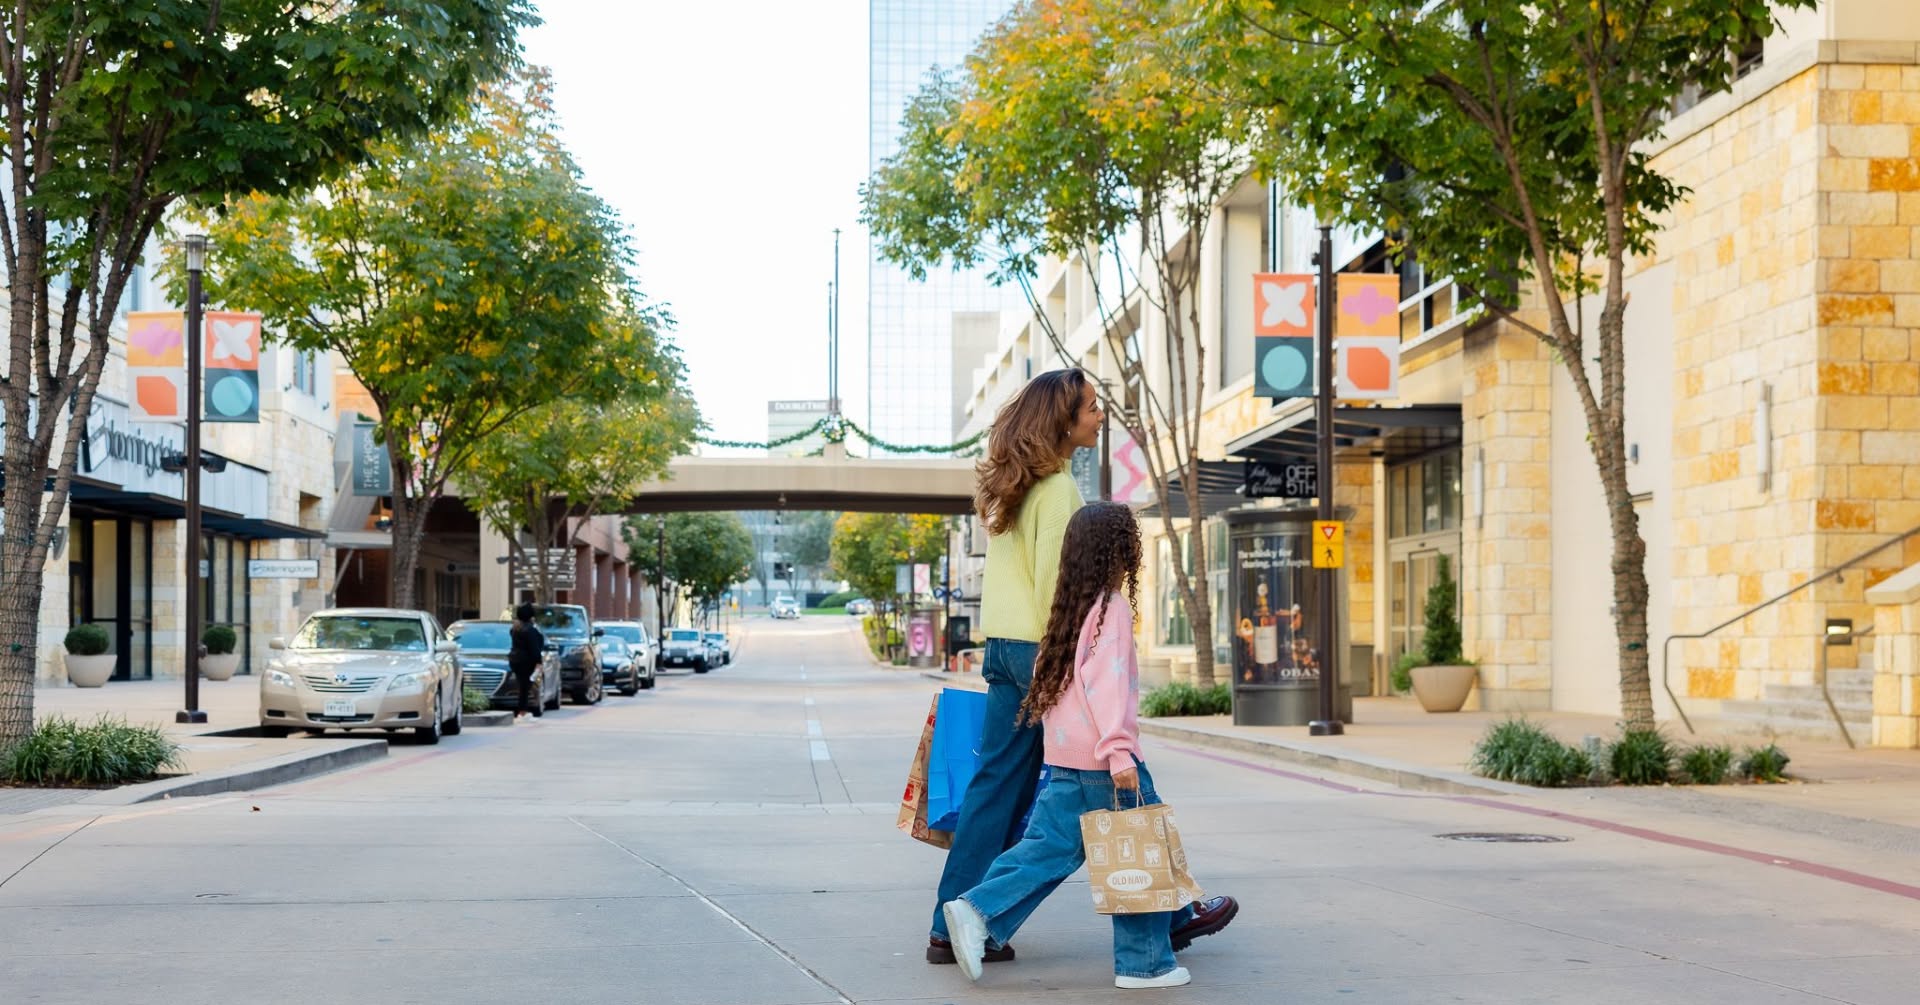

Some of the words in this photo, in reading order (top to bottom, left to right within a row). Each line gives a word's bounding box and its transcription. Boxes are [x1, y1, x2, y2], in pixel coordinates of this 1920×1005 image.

[1286, 465, 1316, 481] OFF
[1286, 480, 1317, 496] 5TH
[1112, 876, 1127, 886] OLD
[1128, 874, 1149, 885] NAVY
